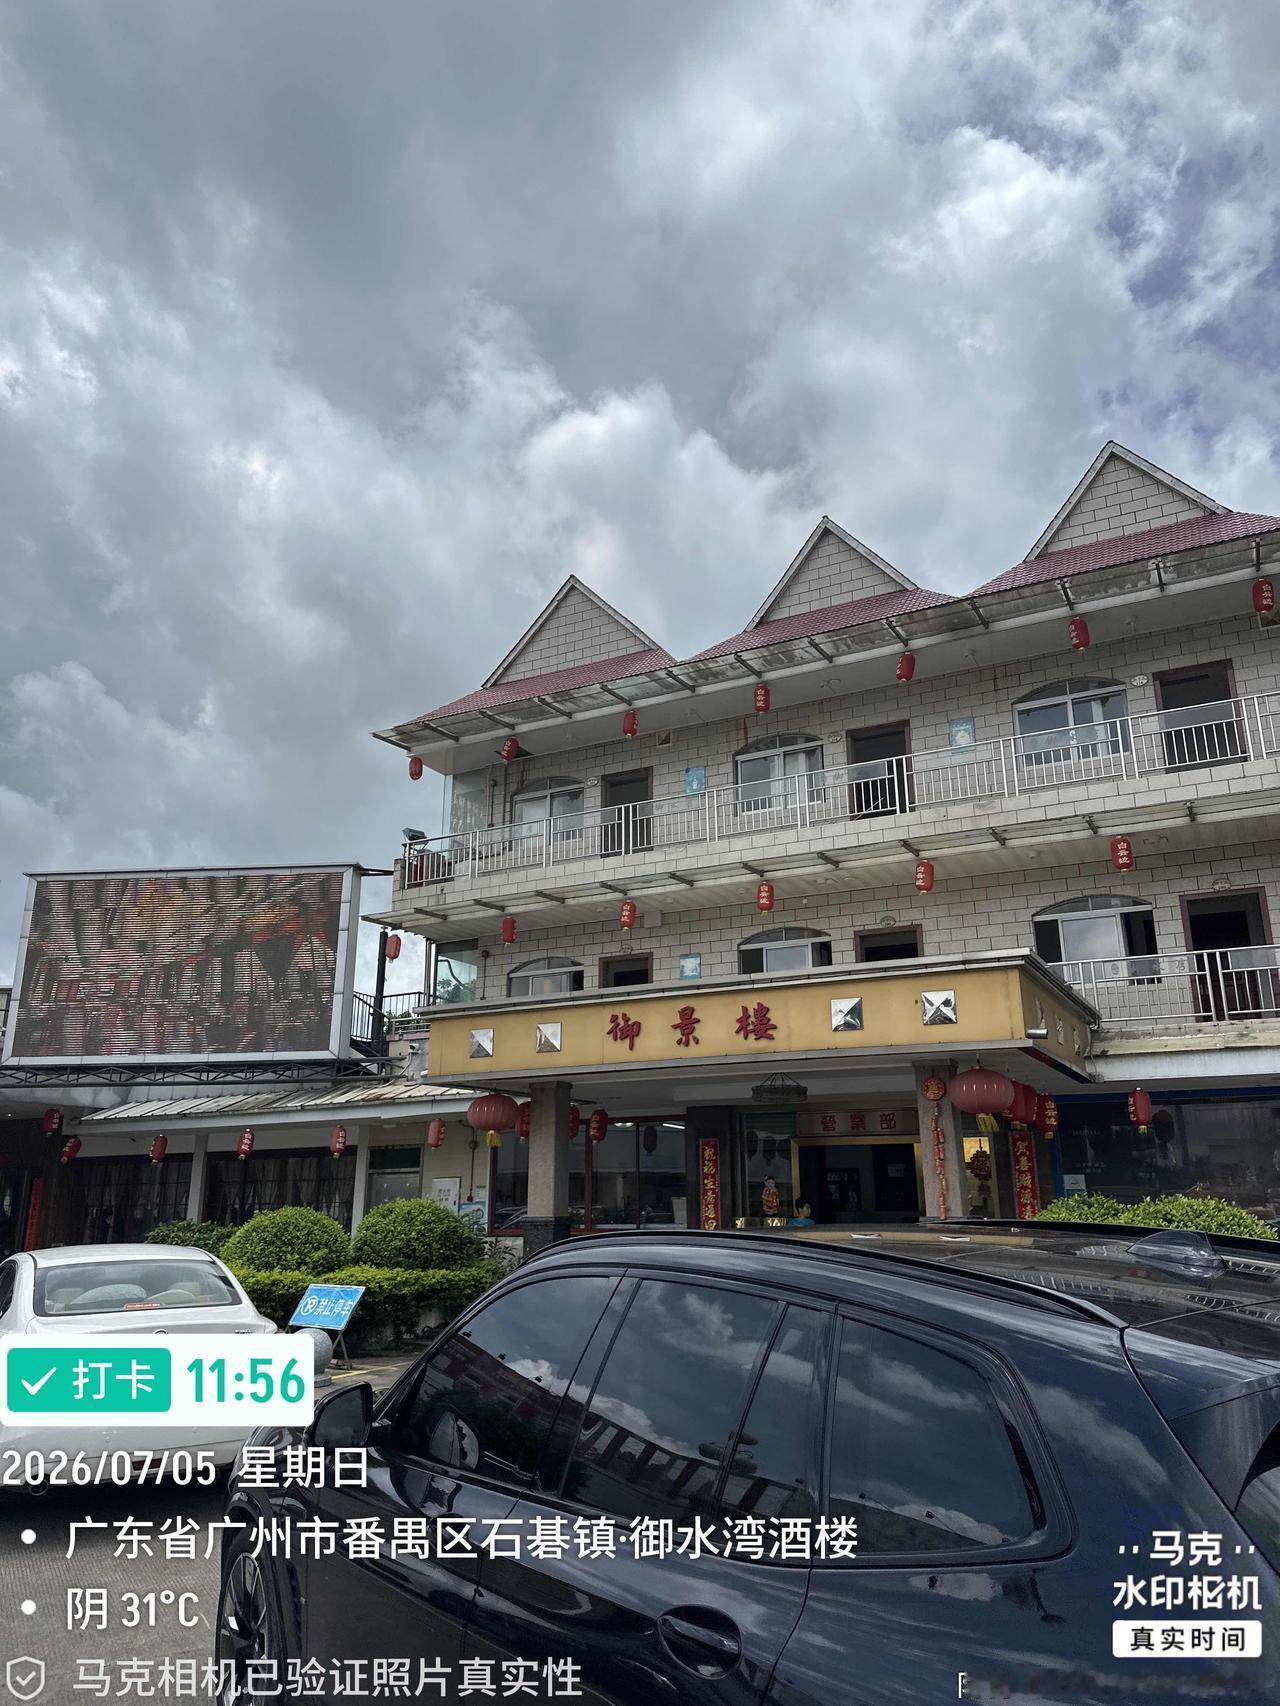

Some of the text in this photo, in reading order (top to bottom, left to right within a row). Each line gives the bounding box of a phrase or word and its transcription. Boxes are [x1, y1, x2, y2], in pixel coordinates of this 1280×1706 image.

[606, 1002, 778, 1051] 御景樓
[821, 1112, 897, 1132] 營業部
